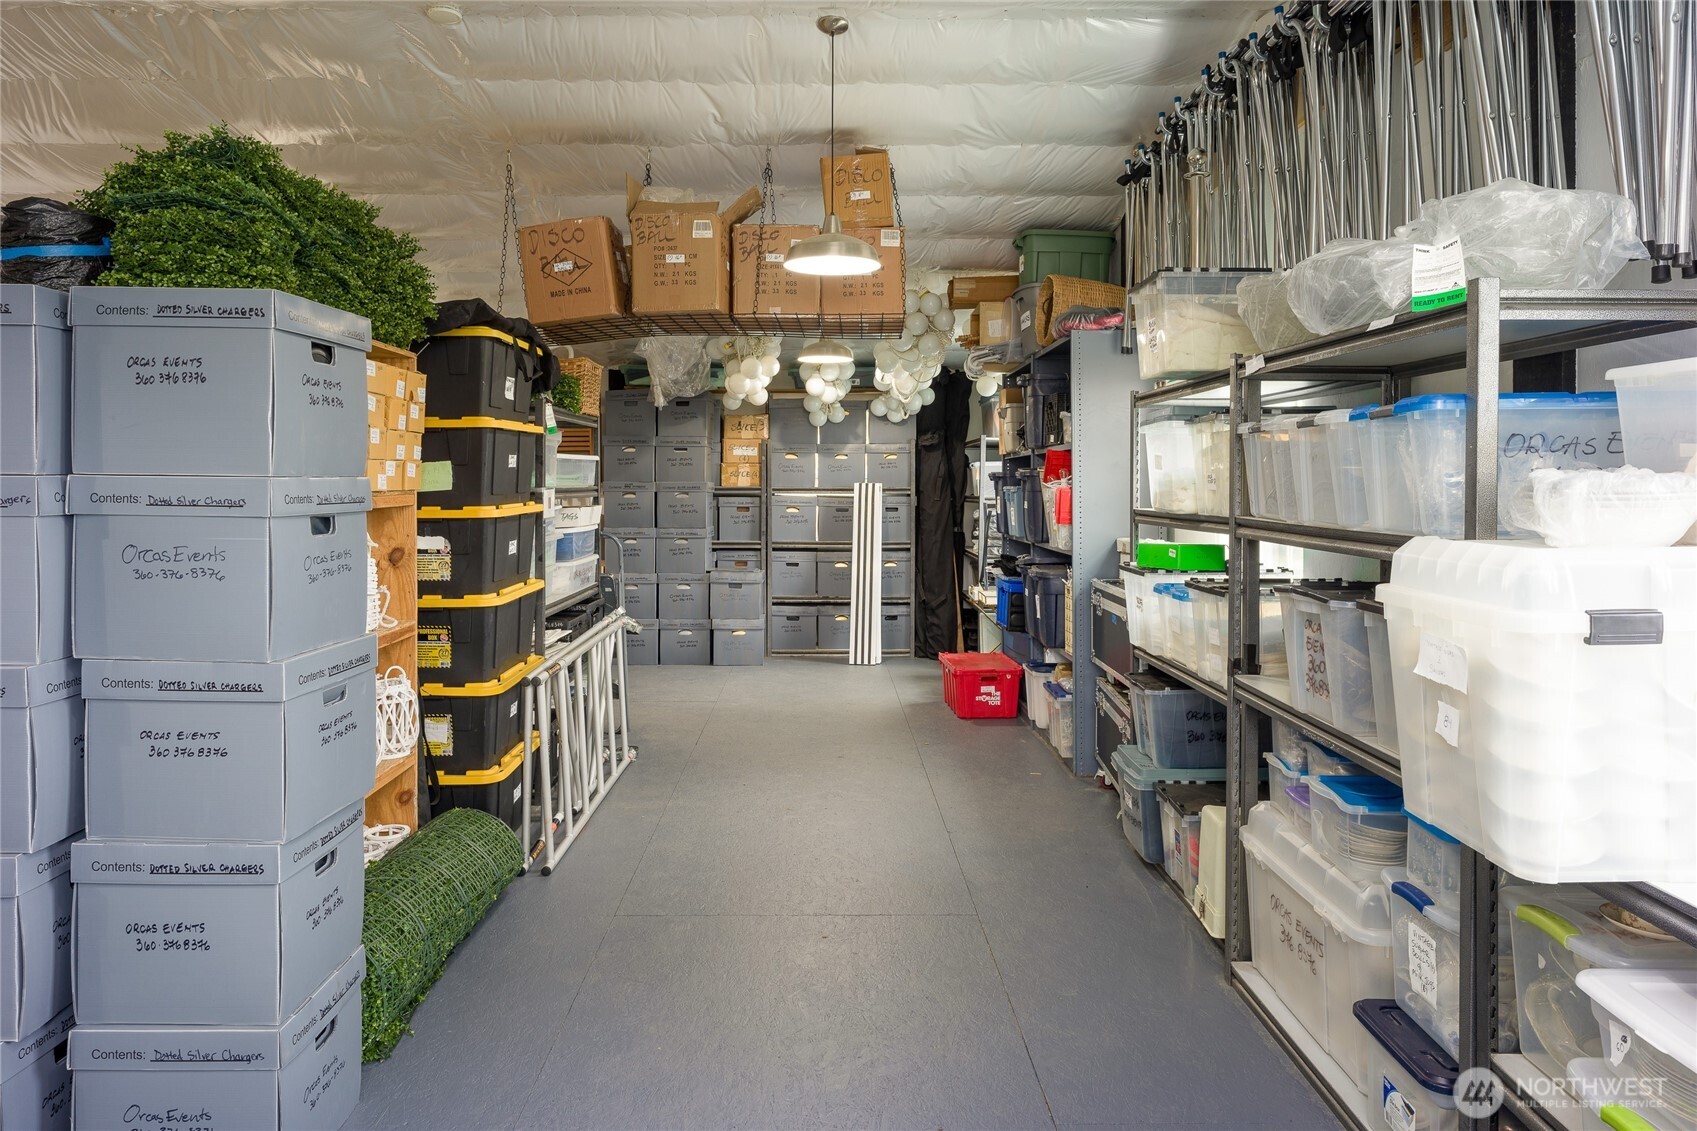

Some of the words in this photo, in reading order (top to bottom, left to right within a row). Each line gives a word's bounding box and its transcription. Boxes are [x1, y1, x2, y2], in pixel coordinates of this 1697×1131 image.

[635, 215, 670, 231] DISCO
[528, 227, 585, 255] DISCO
[1442, 240, 1458, 250] SAFETY
[550, 289, 567, 298] MADE
[567, 288, 574, 296] IN
[574, 286, 592, 296] CHINA
[1414, 298, 1435, 307] READY
[1446, 293, 1463, 302] RENT
[96, 304, 149, 315] Contents:
[185, 304, 213, 316] SILVER
[217, 306, 265, 318] CHARGERS
[127, 356, 156, 368] ORCAS
[162, 356, 203, 368] EVENTS
[1503, 432, 1597, 459] ORCAS
[90, 493, 142, 504] Contents:
[176, 494, 202, 506] Silver
[204, 494, 247, 509] Chargers
[284, 493, 315, 505] Contents:
[560, 512, 579, 522] TAGS
[121, 543, 171, 564] Orcas
[173, 545, 226, 563] Events
[101, 677, 154, 689] Contents:
[158, 679, 187, 691] DOTTED
[190, 681, 217, 692] SILVER
[220, 682, 263, 693] CHARGERS
[298, 669, 327, 686] Contents:
[139, 730, 171, 741] ORCAS
[176, 730, 221, 741] EVENTS
[149, 745, 170, 758] 360
[293, 840, 320, 863] Contents:
[91, 861, 146, 872] Contents:
[150, 863, 181, 874] DOTTED
[184, 863, 217, 874] SILVER
[219, 863, 265, 876] CHARGERS
[52, 915, 71, 934] ORCA
[125, 922, 158, 934] ORCAS
[162, 922, 206, 934] EVENTS
[291, 1014, 319, 1046] Contents:
[18, 1025, 59, 1060] Contents:
[91, 1048, 146, 1060] Contents:
[153, 1049, 183, 1061] Dotted
[187, 1049, 216, 1061] Silver
[221, 1049, 265, 1065] Chargers
[122, 1104, 164, 1123] Orcas
[166, 1107, 212, 1123] Events
